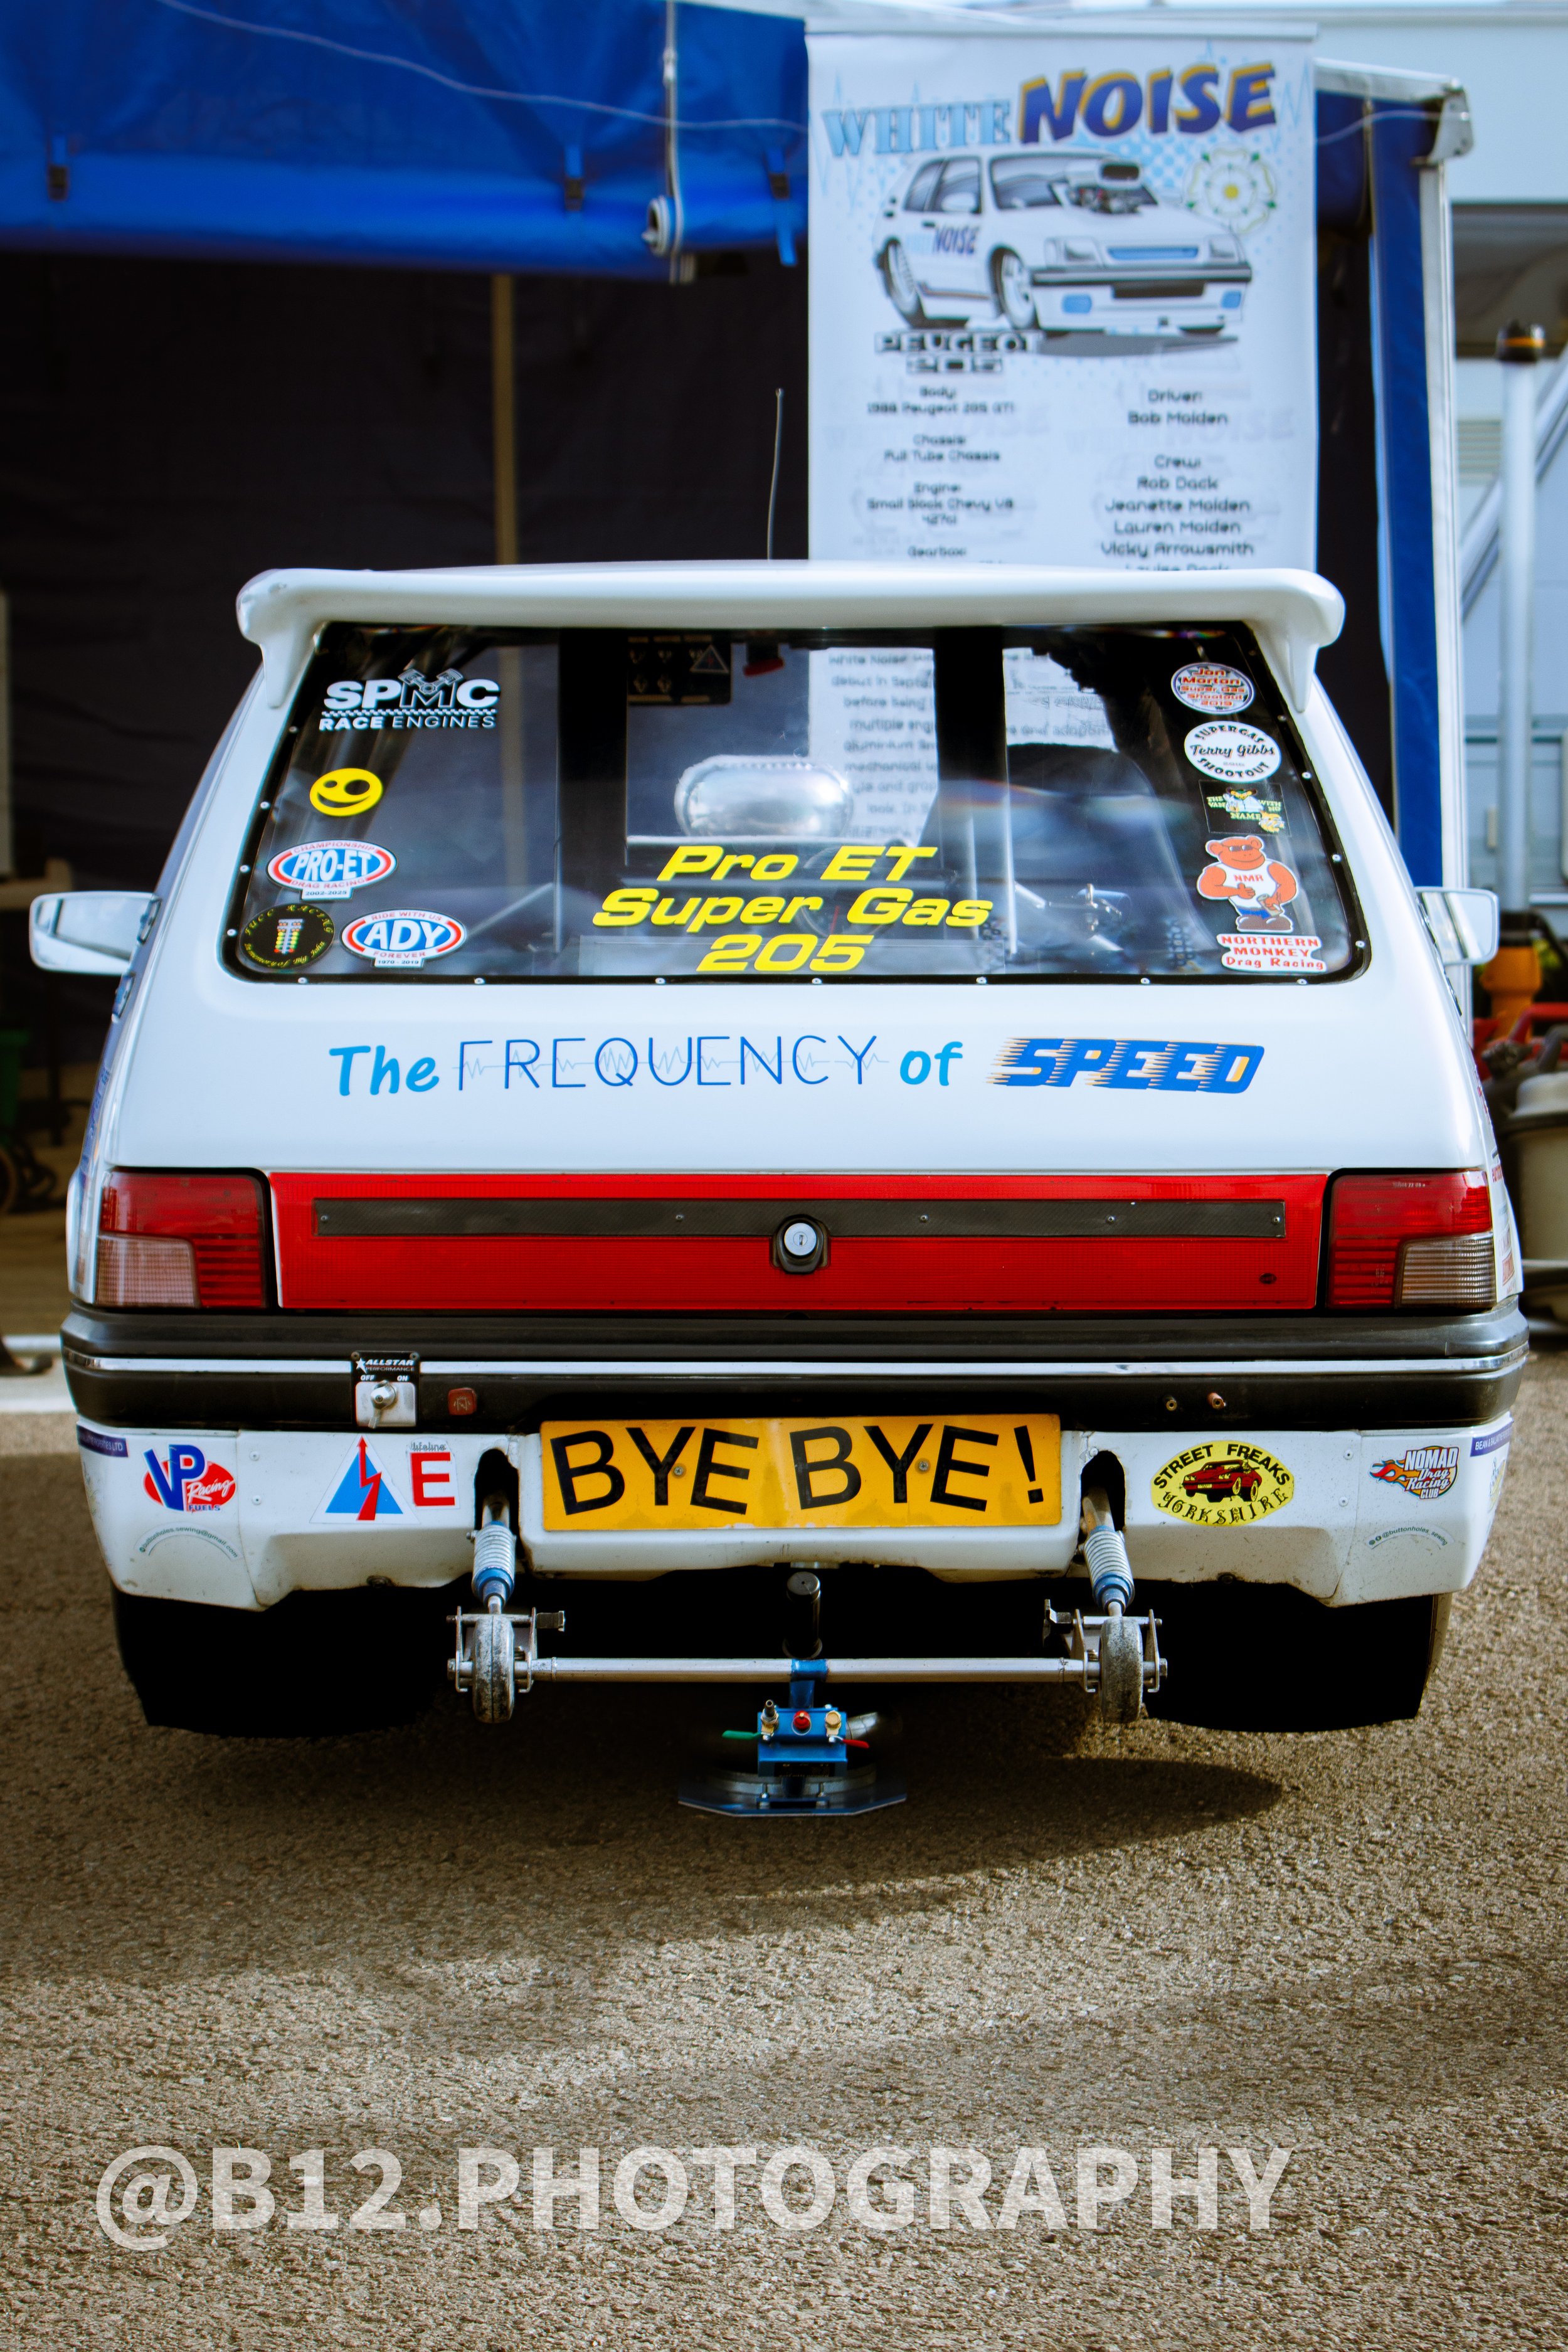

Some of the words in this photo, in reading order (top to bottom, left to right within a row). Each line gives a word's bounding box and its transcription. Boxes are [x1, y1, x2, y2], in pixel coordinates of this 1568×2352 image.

[822, 98, 1011, 157] WHITE
[1019, 61, 1276, 144] NOISE
[931, 225, 980, 255] NOISE
[875, 330, 1046, 353] PEUGEOT
[901, 401, 958, 416] Peugeot
[1128, 411, 1161, 424] Bob
[913, 450, 944, 462] Tube
[948, 450, 1000, 462] Chassis
[1137, 477, 1169, 490] Rob
[867, 497, 903, 510] Small
[948, 497, 990, 512] Chevy
[995, 497, 1014, 509] V8
[1105, 499, 1182, 512] Jeanette
[1114, 521, 1173, 534] Lauren
[1101, 541, 1148, 558] Vicky
[1154, 541, 1254, 555] Arrowsmith
[1193, 667, 1226, 676] Jon
[1182, 677, 1241, 685] Morton
[324, 669, 501, 710] SPMC
[319, 717, 384, 731] RACE
[392, 716, 497, 729] ENGINES
[1194, 724, 1264, 743] SUPERGAS
[1190, 744, 1233, 758] Terry
[1236, 744, 1275, 757] Gibbs
[1197, 758, 1269, 777] SHOOTOUT
[1258, 799, 1281, 807] WITH
[1230, 812, 1262, 820] NAME
[294, 841, 375, 854] CHAMPIONSHIP
[291, 849, 371, 881] PRO-ET
[657, 845, 799, 881] Pro
[820, 845, 939, 881] ET
[290, 879, 320, 888] DRAG
[324, 878, 366, 888] RACING
[1234, 874, 1264, 882] NMR
[372, 912, 395, 921] RIDE
[429, 913, 442, 921] US
[593, 887, 824, 933] Super
[846, 887, 993, 928] Gas
[364, 919, 445, 951] ADY
[1221, 936, 1318, 947] NORTHERN
[310, 941, 326, 958] John
[373, 951, 426, 959] FOREVER
[696, 934, 874, 972] 205
[1233, 947, 1310, 957] MONKEY
[1226, 956, 1261, 968] Drag
[1270, 958, 1324, 970] Racing
[329, 1045, 440, 1096] The
[458, 1035, 877, 1091] FREQUENCY
[899, 1041, 963, 1087] of
[986, 1037, 1264, 1094] SPEED
[112, 1442, 124, 1451] LTD
[1475, 1439, 1488, 1451] BEAN
[1153, 1444, 1213, 1489] STREET
[1227, 1443, 1290, 1486] FREAKS
[1404, 1448, 1459, 1471] NOMAD
[144, 1444, 206, 1512] VP
[550, 1426, 760, 1515] BYE
[1417, 1468, 1449, 1481] Drag
[410, 1452, 455, 1507] E
[1406, 1478, 1450, 1491] Racing
[187, 1478, 235, 1503] Racing
[1419, 1488, 1439, 1499] CLUB
[1158, 1487, 1289, 1525] YORKSHIRE
[142, 1527, 238, 1558] buttonholes.sewing@gmail.com
